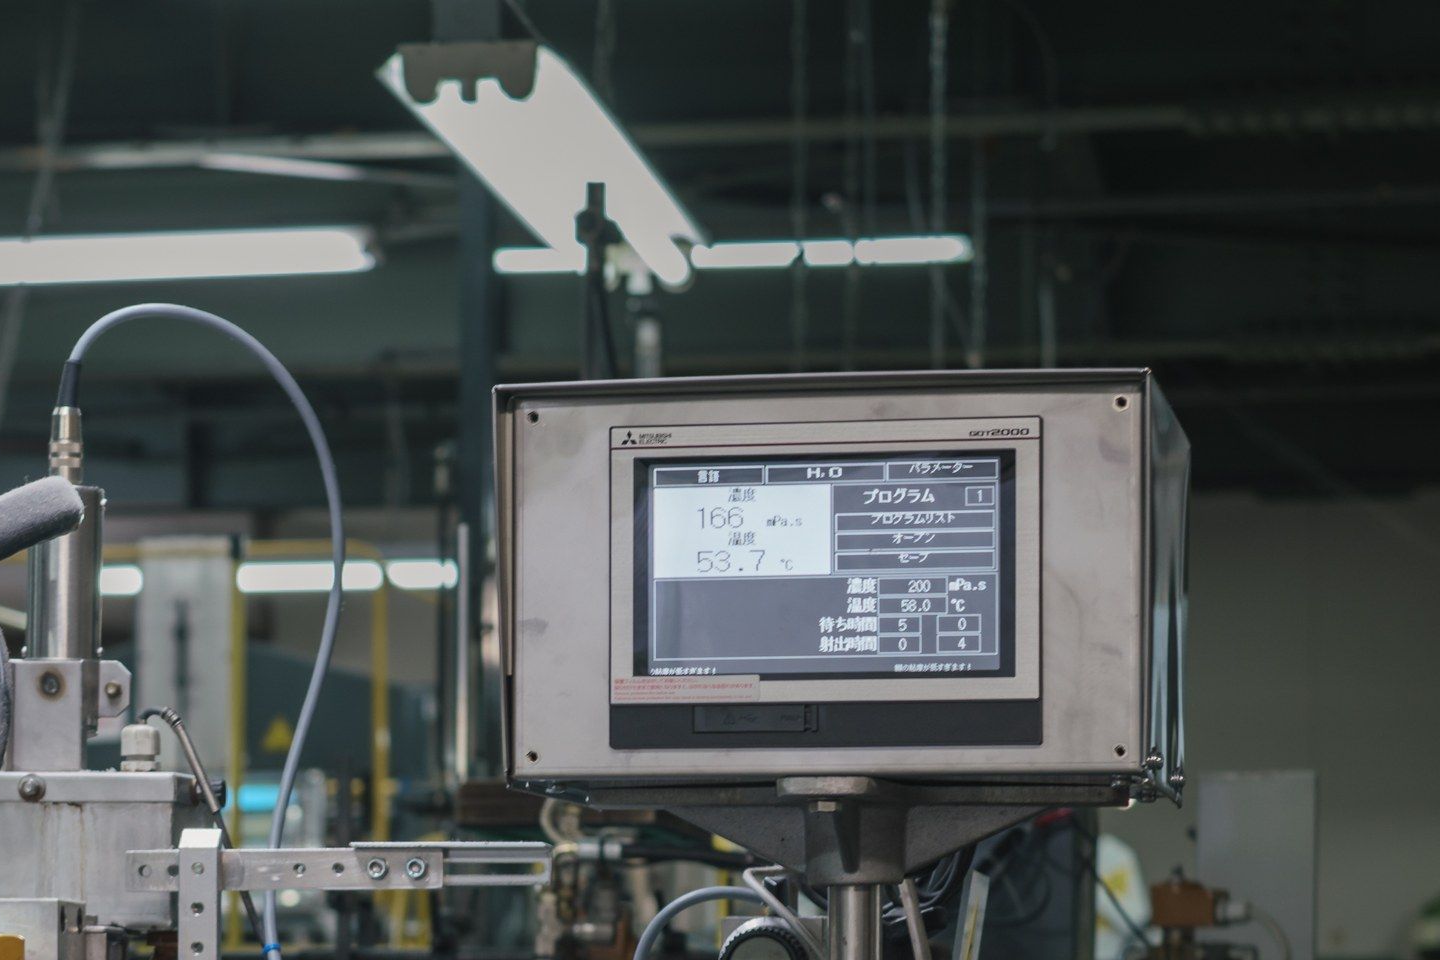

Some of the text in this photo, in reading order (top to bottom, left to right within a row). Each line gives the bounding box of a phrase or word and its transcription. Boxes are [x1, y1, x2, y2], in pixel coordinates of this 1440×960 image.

[862, 487, 936, 505] プログラム
[976, 489, 984, 503] 1
[697, 506, 745, 530] 166
[697, 549, 766, 573] 53.7
[907, 579, 932, 594] 200
[818, 616, 968, 633] 待ち時間 5 0
[818, 635, 968, 653] 射出時間 0 4
